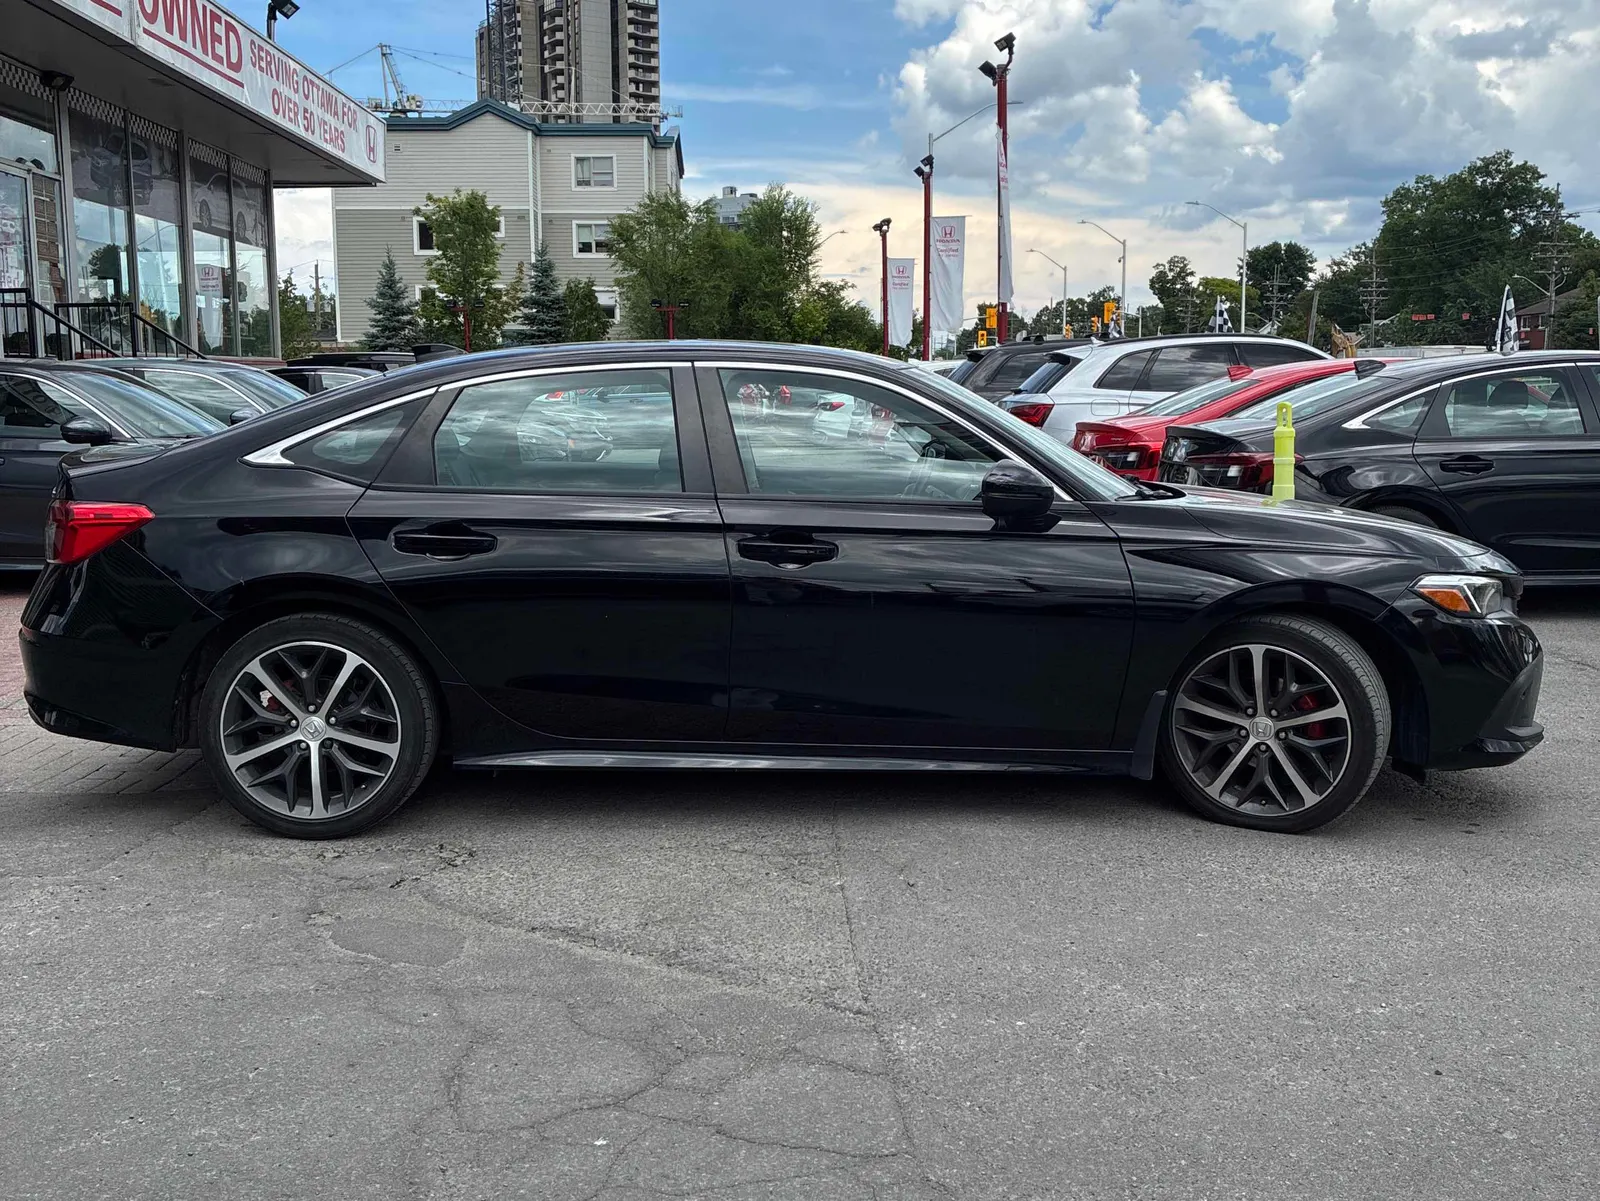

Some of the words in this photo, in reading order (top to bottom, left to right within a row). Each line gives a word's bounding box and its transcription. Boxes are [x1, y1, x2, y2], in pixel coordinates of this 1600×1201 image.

[250, 39, 299, 95] SERVING
[302, 75, 339, 121] OTTAWA
[341, 101, 357, 132] FOR
[271, 88, 300, 127] OVER
[303, 107, 316, 136] 50
[317, 114, 345, 154] YEARS
